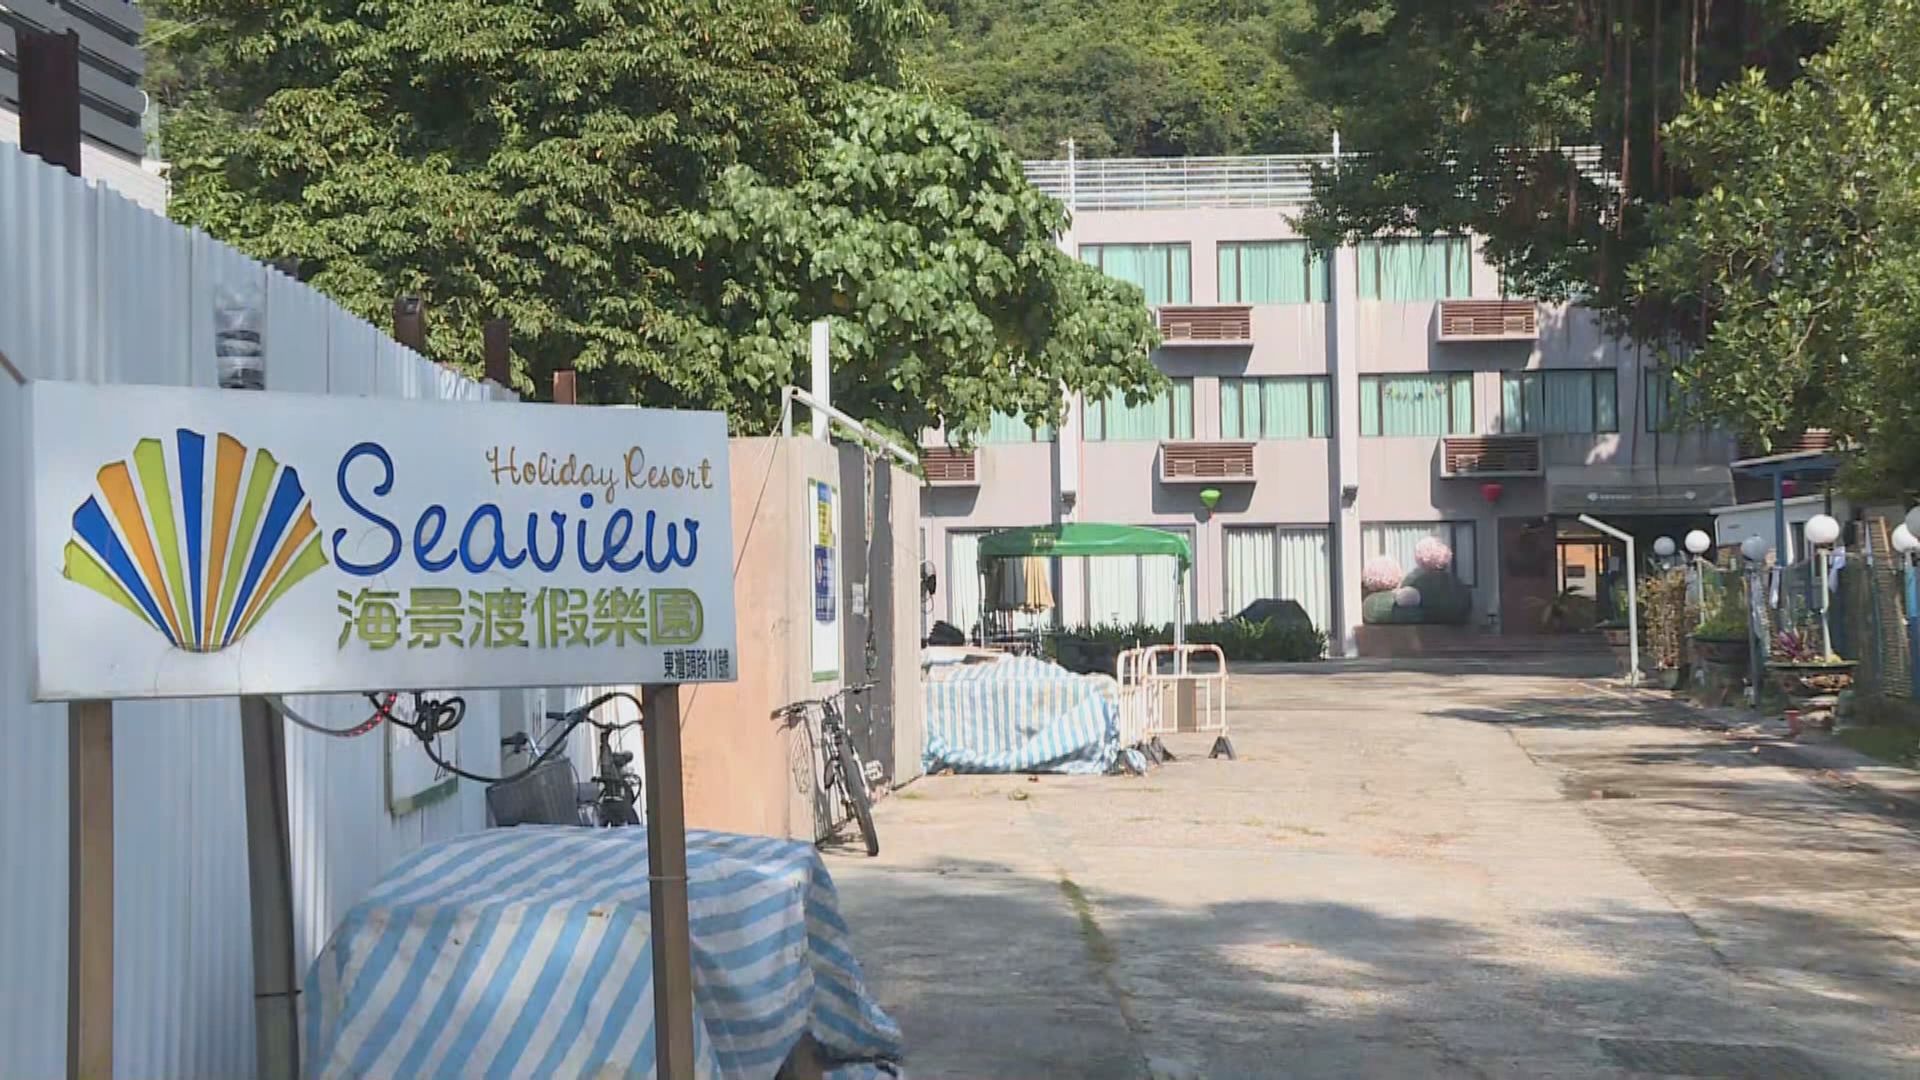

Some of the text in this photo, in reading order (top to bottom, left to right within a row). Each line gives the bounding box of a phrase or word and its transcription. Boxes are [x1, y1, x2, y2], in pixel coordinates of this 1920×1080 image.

[486, 446, 713, 504] Holiday Resort
[332, 441, 699, 576] Seaview
[337, 586, 704, 650] 海景渡假樂園
